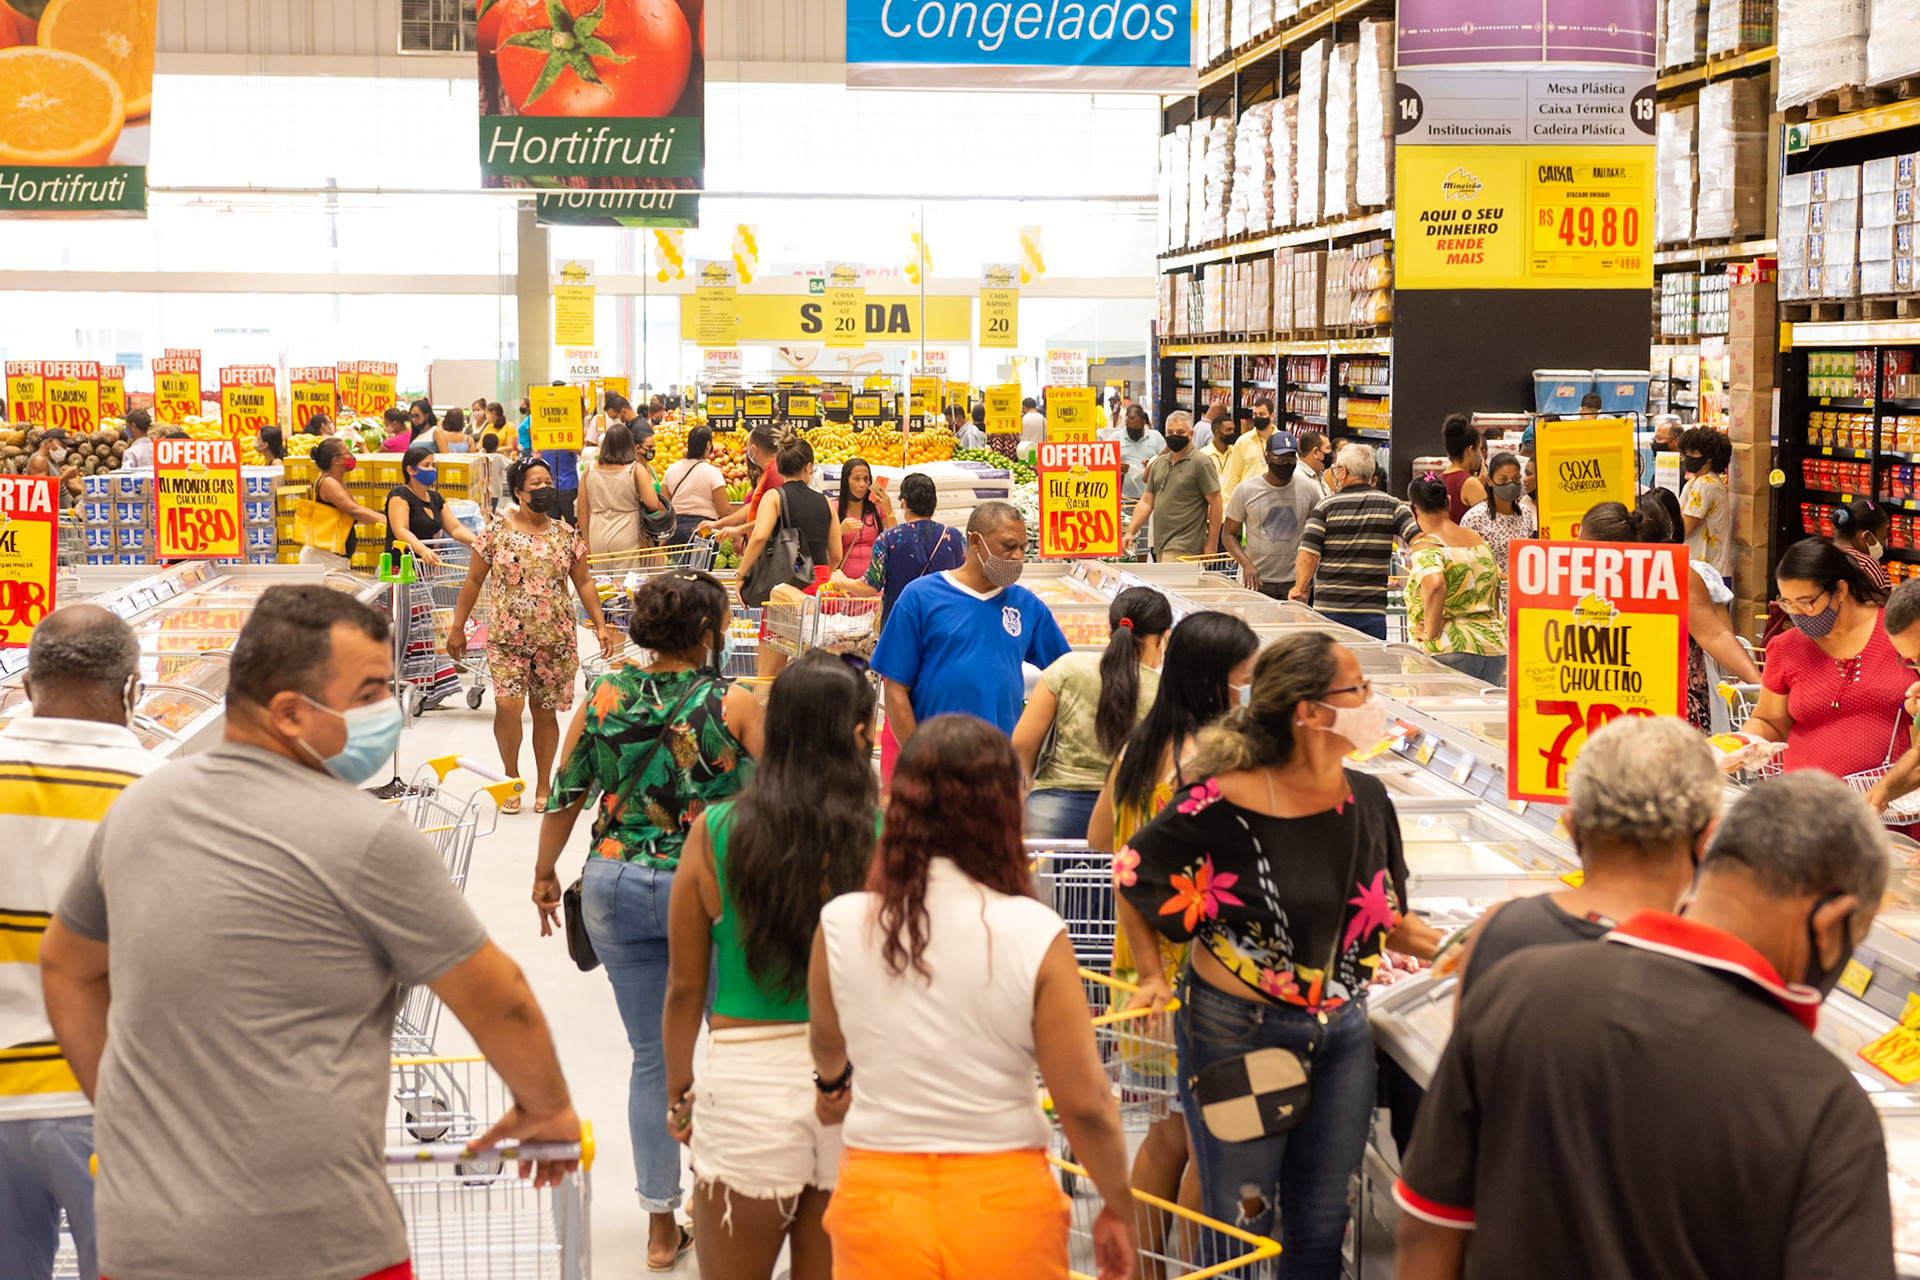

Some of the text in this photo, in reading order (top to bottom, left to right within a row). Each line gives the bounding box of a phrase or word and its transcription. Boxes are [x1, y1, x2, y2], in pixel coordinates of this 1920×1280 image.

[881, 0, 1178, 51] Congelados
[1547, 82, 1626, 95] Mesa Plástica
[1399, 98, 1419, 120] 14
[1539, 102, 1625, 115] Caixa Térmica
[1634, 98, 1655, 121] 13
[1428, 123, 1513, 136] Institucionais
[1533, 123, 1626, 136] Cadeira Plástica
[486, 126, 676, 165] Hortifruti
[0, 172, 129, 202] Hortifruti
[1419, 207, 1504, 223] AQUI O SEU
[1426, 222, 1499, 237] DINHEIRO
[1538, 206, 1639, 249] R$ 49,80
[1436, 237, 1485, 251] RENDE
[1446, 251, 1485, 265] MAIS
[834, 317, 856, 332] 20
[988, 318, 1010, 332] 20
[568, 351, 599, 359] OFERTA
[708, 352, 738, 360] OFERTA
[1052, 352, 1083, 361] OFERTA
[6, 361, 42, 375] OFERT
[44, 362, 98, 378] OFERTA
[100, 366, 124, 378] ERTA
[154, 359, 199, 372] OFERTA
[359, 362, 398, 375] OFERTA
[221, 368, 275, 384] OFERTA
[290, 368, 335, 381] OFERTA
[230, 392, 265, 407] BANANA
[910, 420, 922, 428] 48
[157, 440, 237, 465] OFERTA
[1041, 443, 1117, 468] OFERTA
[1559, 458, 1602, 483] COXA
[1076, 480, 1109, 500] PEITO
[166, 506, 237, 552] 15,80
[1048, 510, 1115, 552] 15,80
[1517, 545, 1680, 600] OFERTA
[1544, 618, 1632, 668] CARNE
